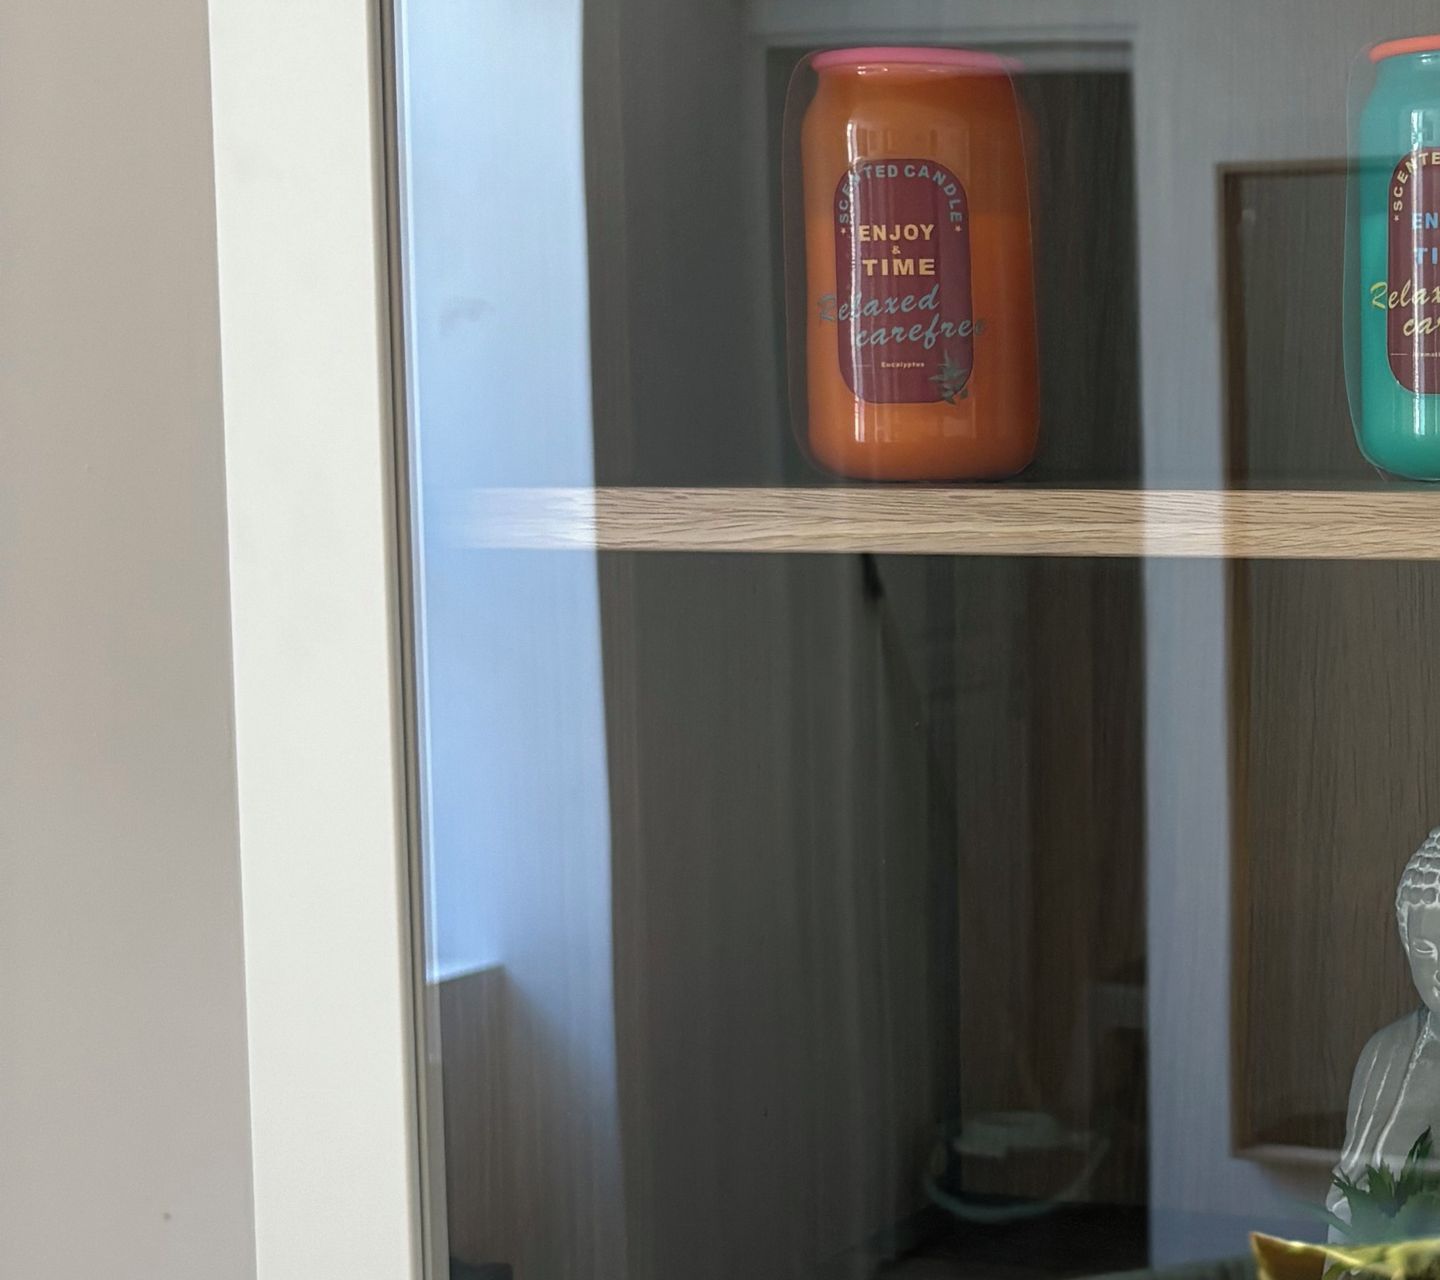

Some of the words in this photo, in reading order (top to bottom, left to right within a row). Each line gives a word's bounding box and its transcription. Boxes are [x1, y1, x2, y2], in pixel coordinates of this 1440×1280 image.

[904, 164, 963, 223] CANDLE
[858, 223, 935, 242] ENJOY
[892, 245, 901, 255] &
[862, 258, 936, 276] TIME
[817, 283, 940, 324] Relaxed
